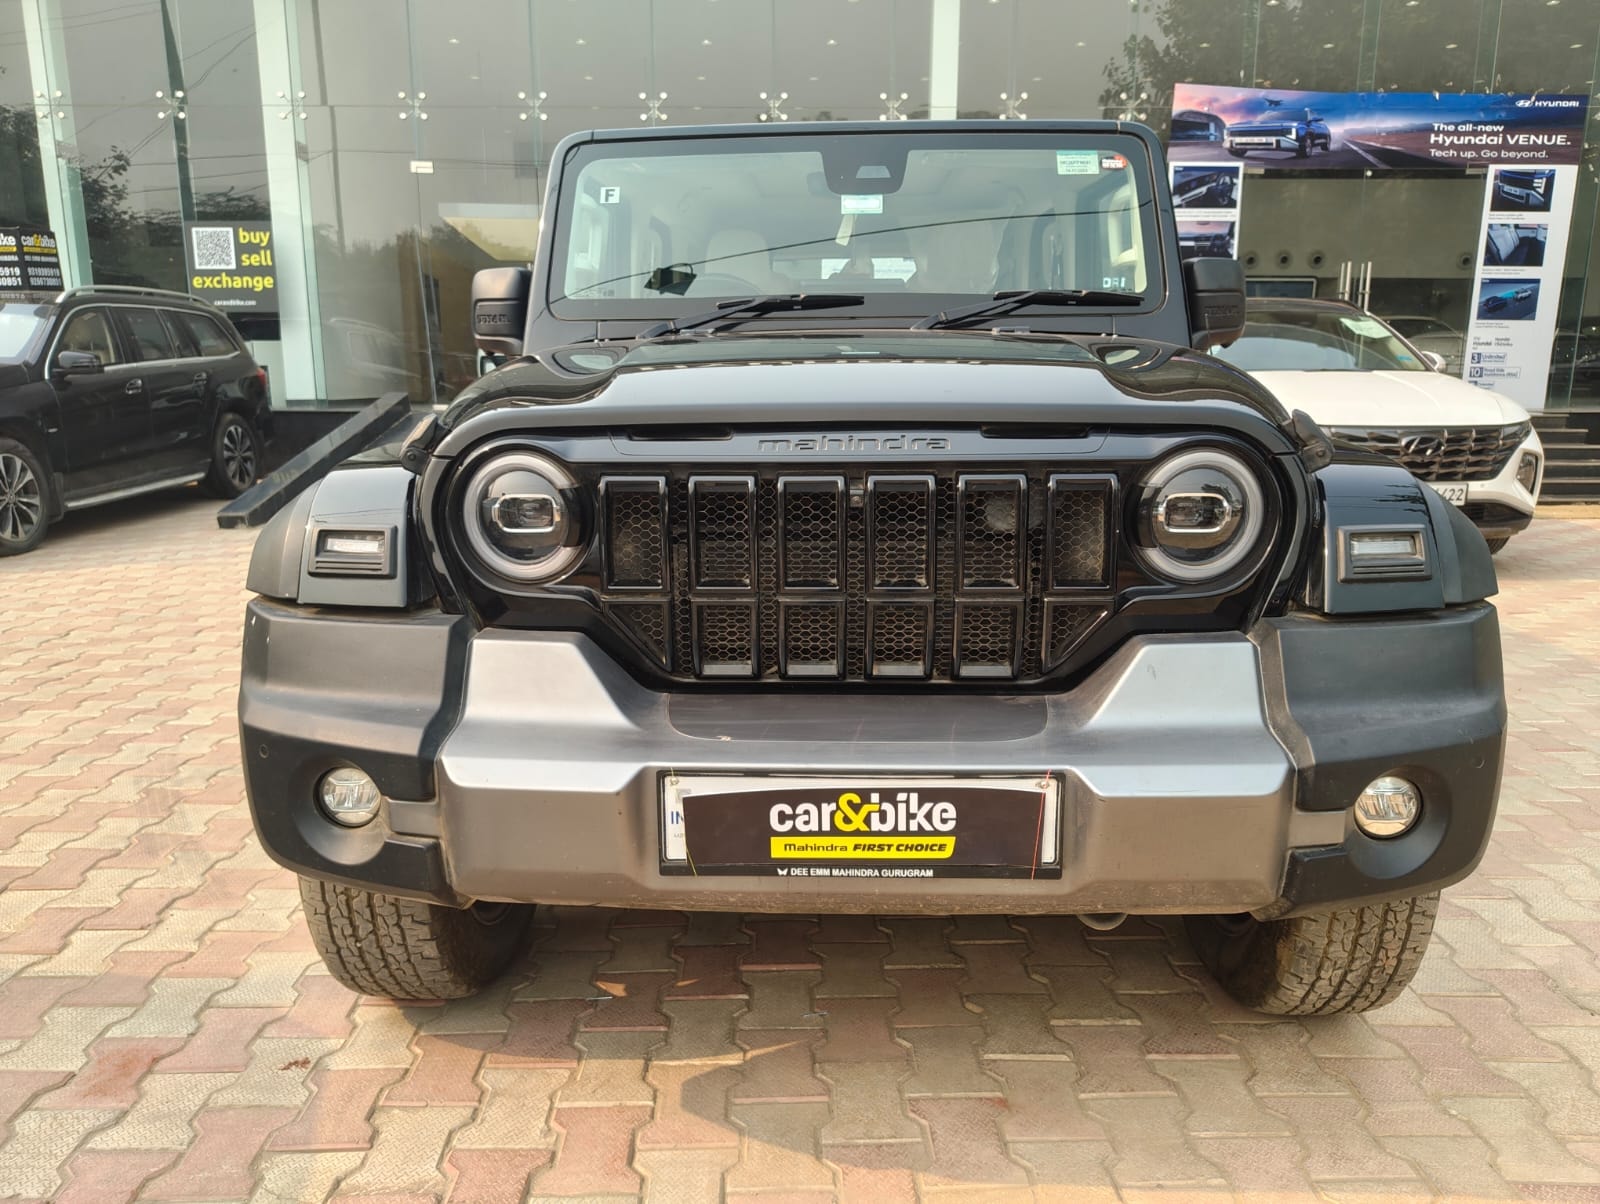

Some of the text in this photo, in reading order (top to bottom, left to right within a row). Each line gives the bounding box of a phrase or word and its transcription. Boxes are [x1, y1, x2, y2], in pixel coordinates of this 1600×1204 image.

[1432, 123, 1504, 132] The all-new
[1430, 133, 1571, 146] Hyundai VENUE.
[1430, 148, 1549, 159] Tech up. Go beyond.
[604, 188, 616, 202] F
[238, 226, 270, 247] buy
[241, 249, 273, 266] sell
[192, 272, 274, 292] exchange
[758, 434, 951, 451] mahindra
[769, 792, 957, 832] car&bike
[784, 843, 947, 852] Mahindra FIRST CHOICE
[790, 867, 934, 877] DEE EMM MAHINDRA GURUGRAM
